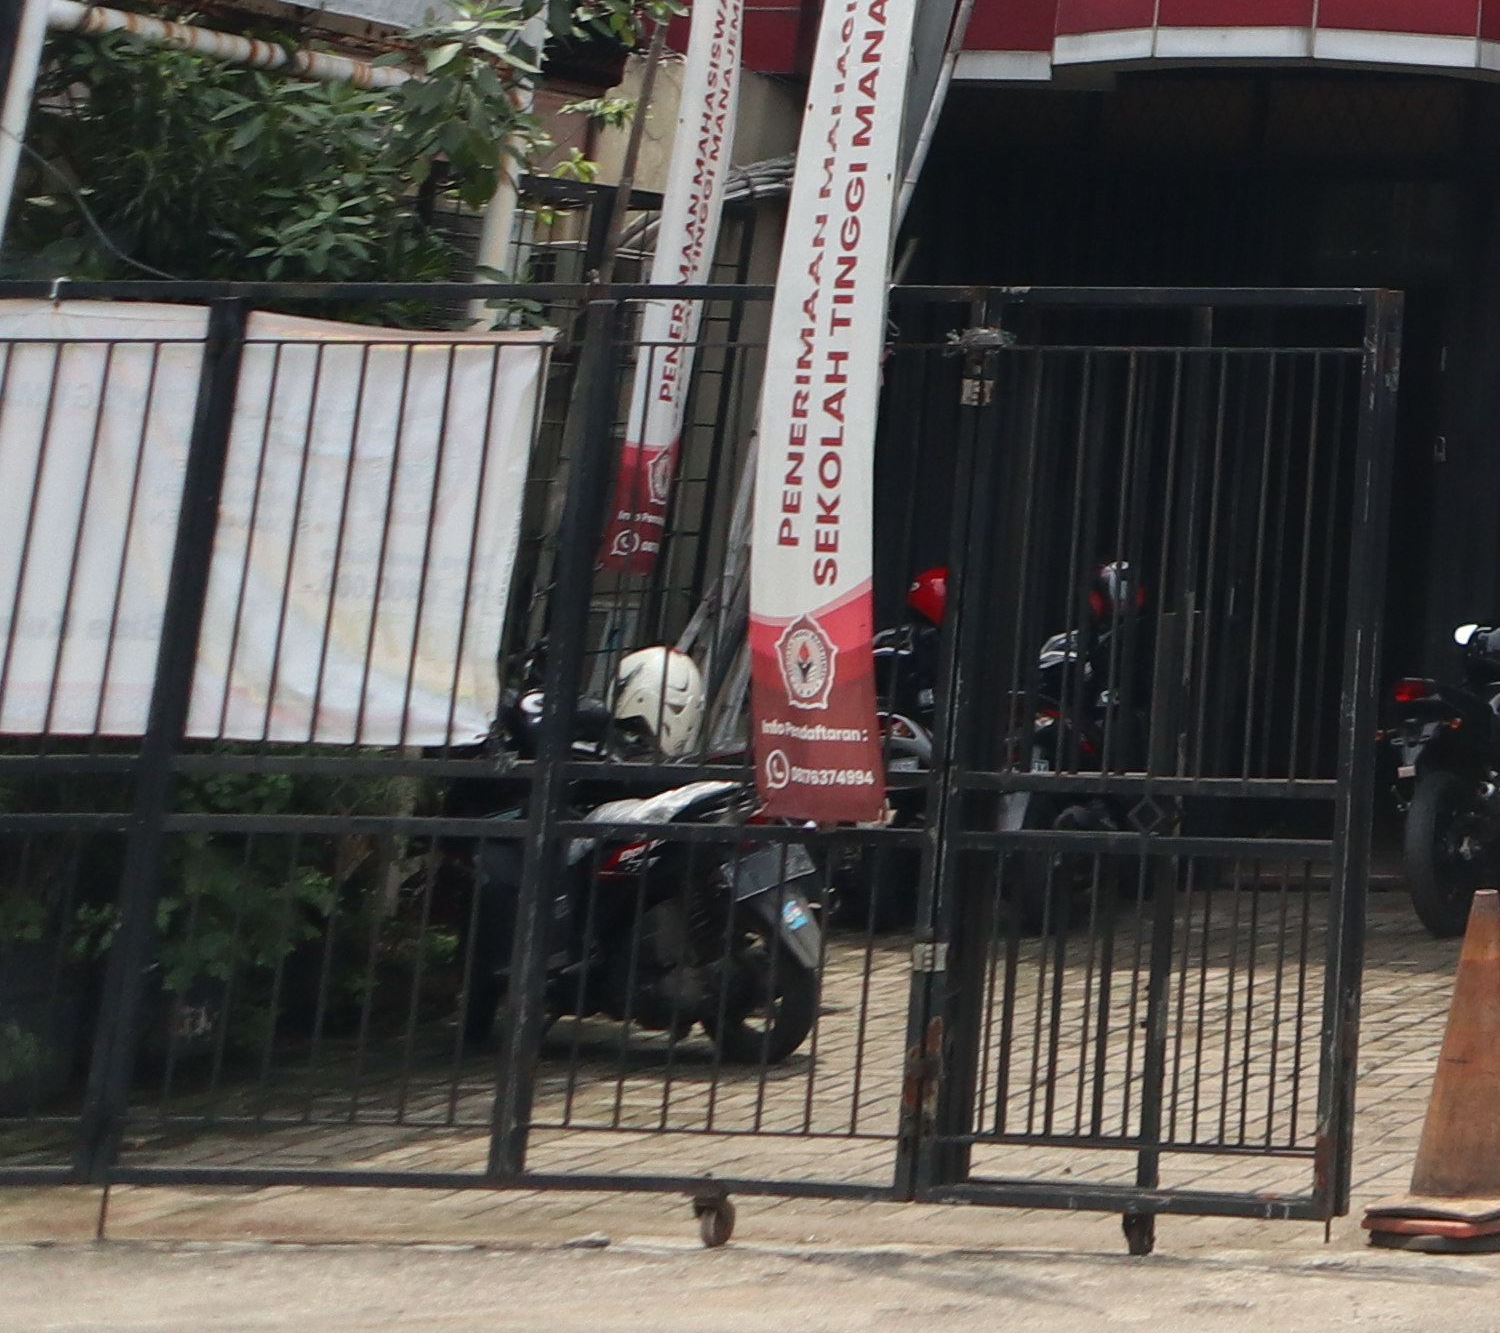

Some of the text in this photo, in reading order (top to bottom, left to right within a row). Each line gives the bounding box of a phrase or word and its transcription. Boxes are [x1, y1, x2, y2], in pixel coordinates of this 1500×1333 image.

[829, 161, 869, 337] TINGGI
[777, 213, 829, 548] PENERIMAAN
[813, 350, 851, 588] SEKOLAH
